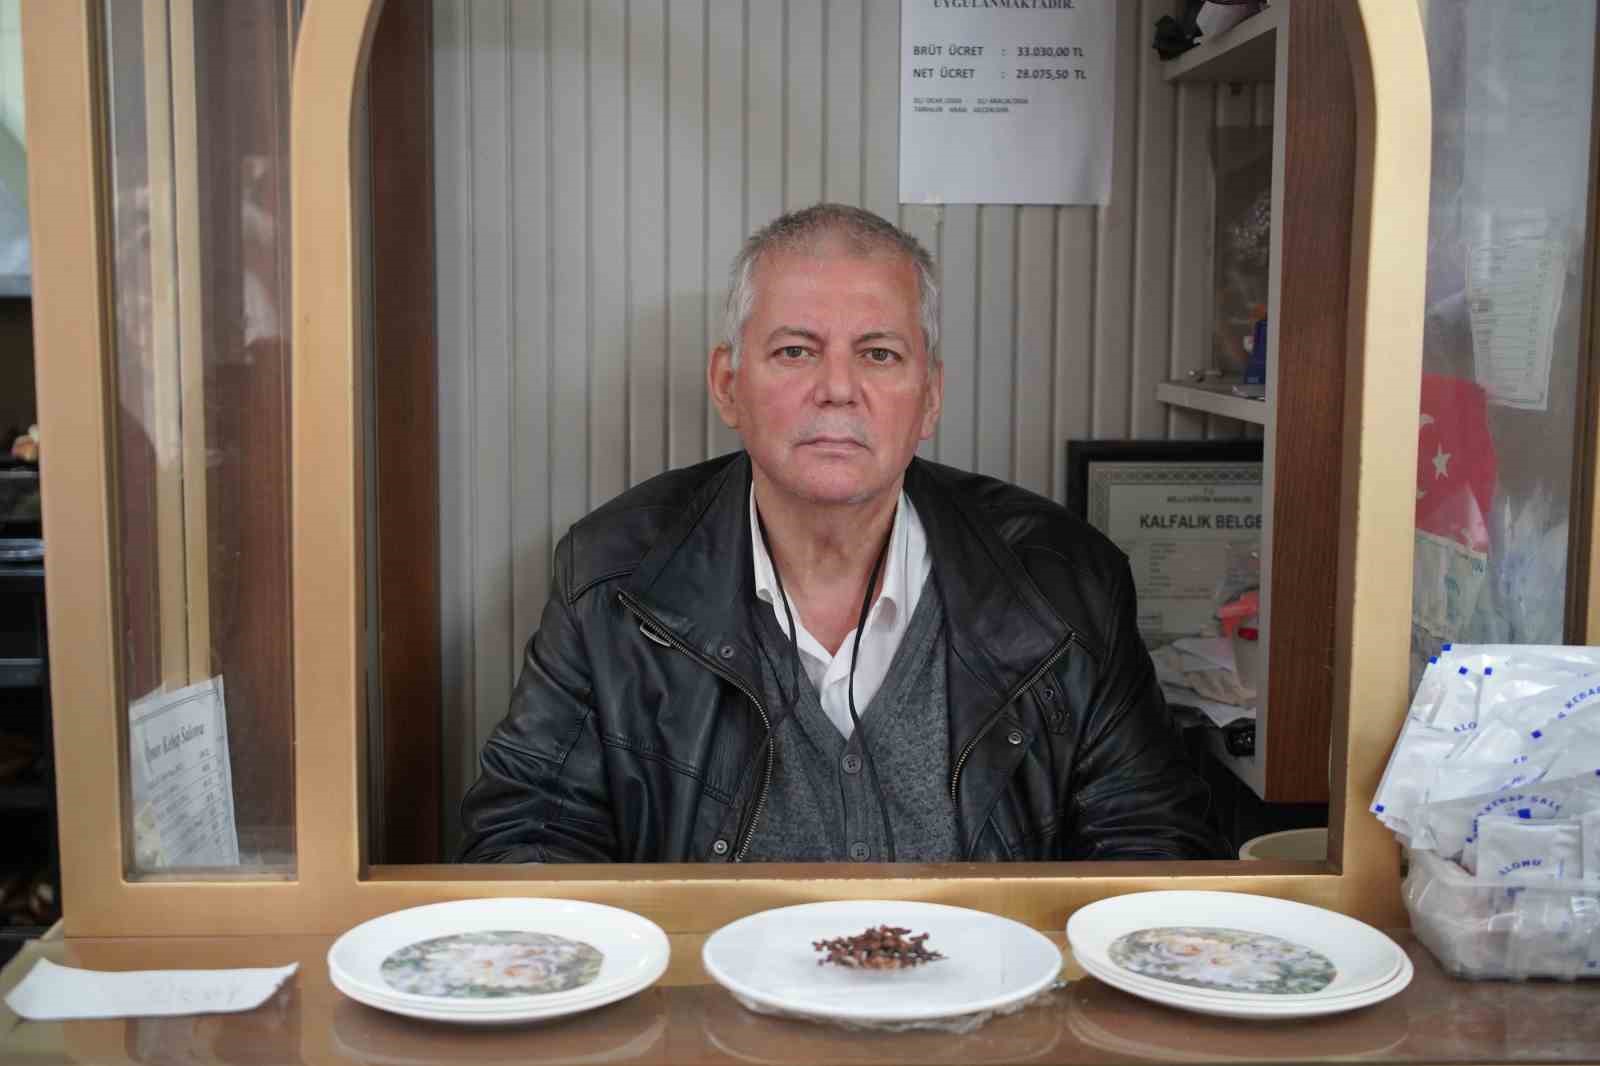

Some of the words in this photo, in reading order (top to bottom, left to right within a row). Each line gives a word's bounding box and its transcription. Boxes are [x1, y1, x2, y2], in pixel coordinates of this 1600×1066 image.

[913, 44, 943, 56] BRÜT
[949, 44, 984, 56] ÜCRET
[1017, 46, 1070, 57] 33.030,00
[1073, 47, 1084, 57] TL
[912, 68, 934, 79] NET
[940, 66, 976, 79] ÜCRET
[1016, 68, 1069, 80] 28.075,50
[1074, 69, 1087, 80] TL
[1139, 513, 1211, 529] KALFALIK
